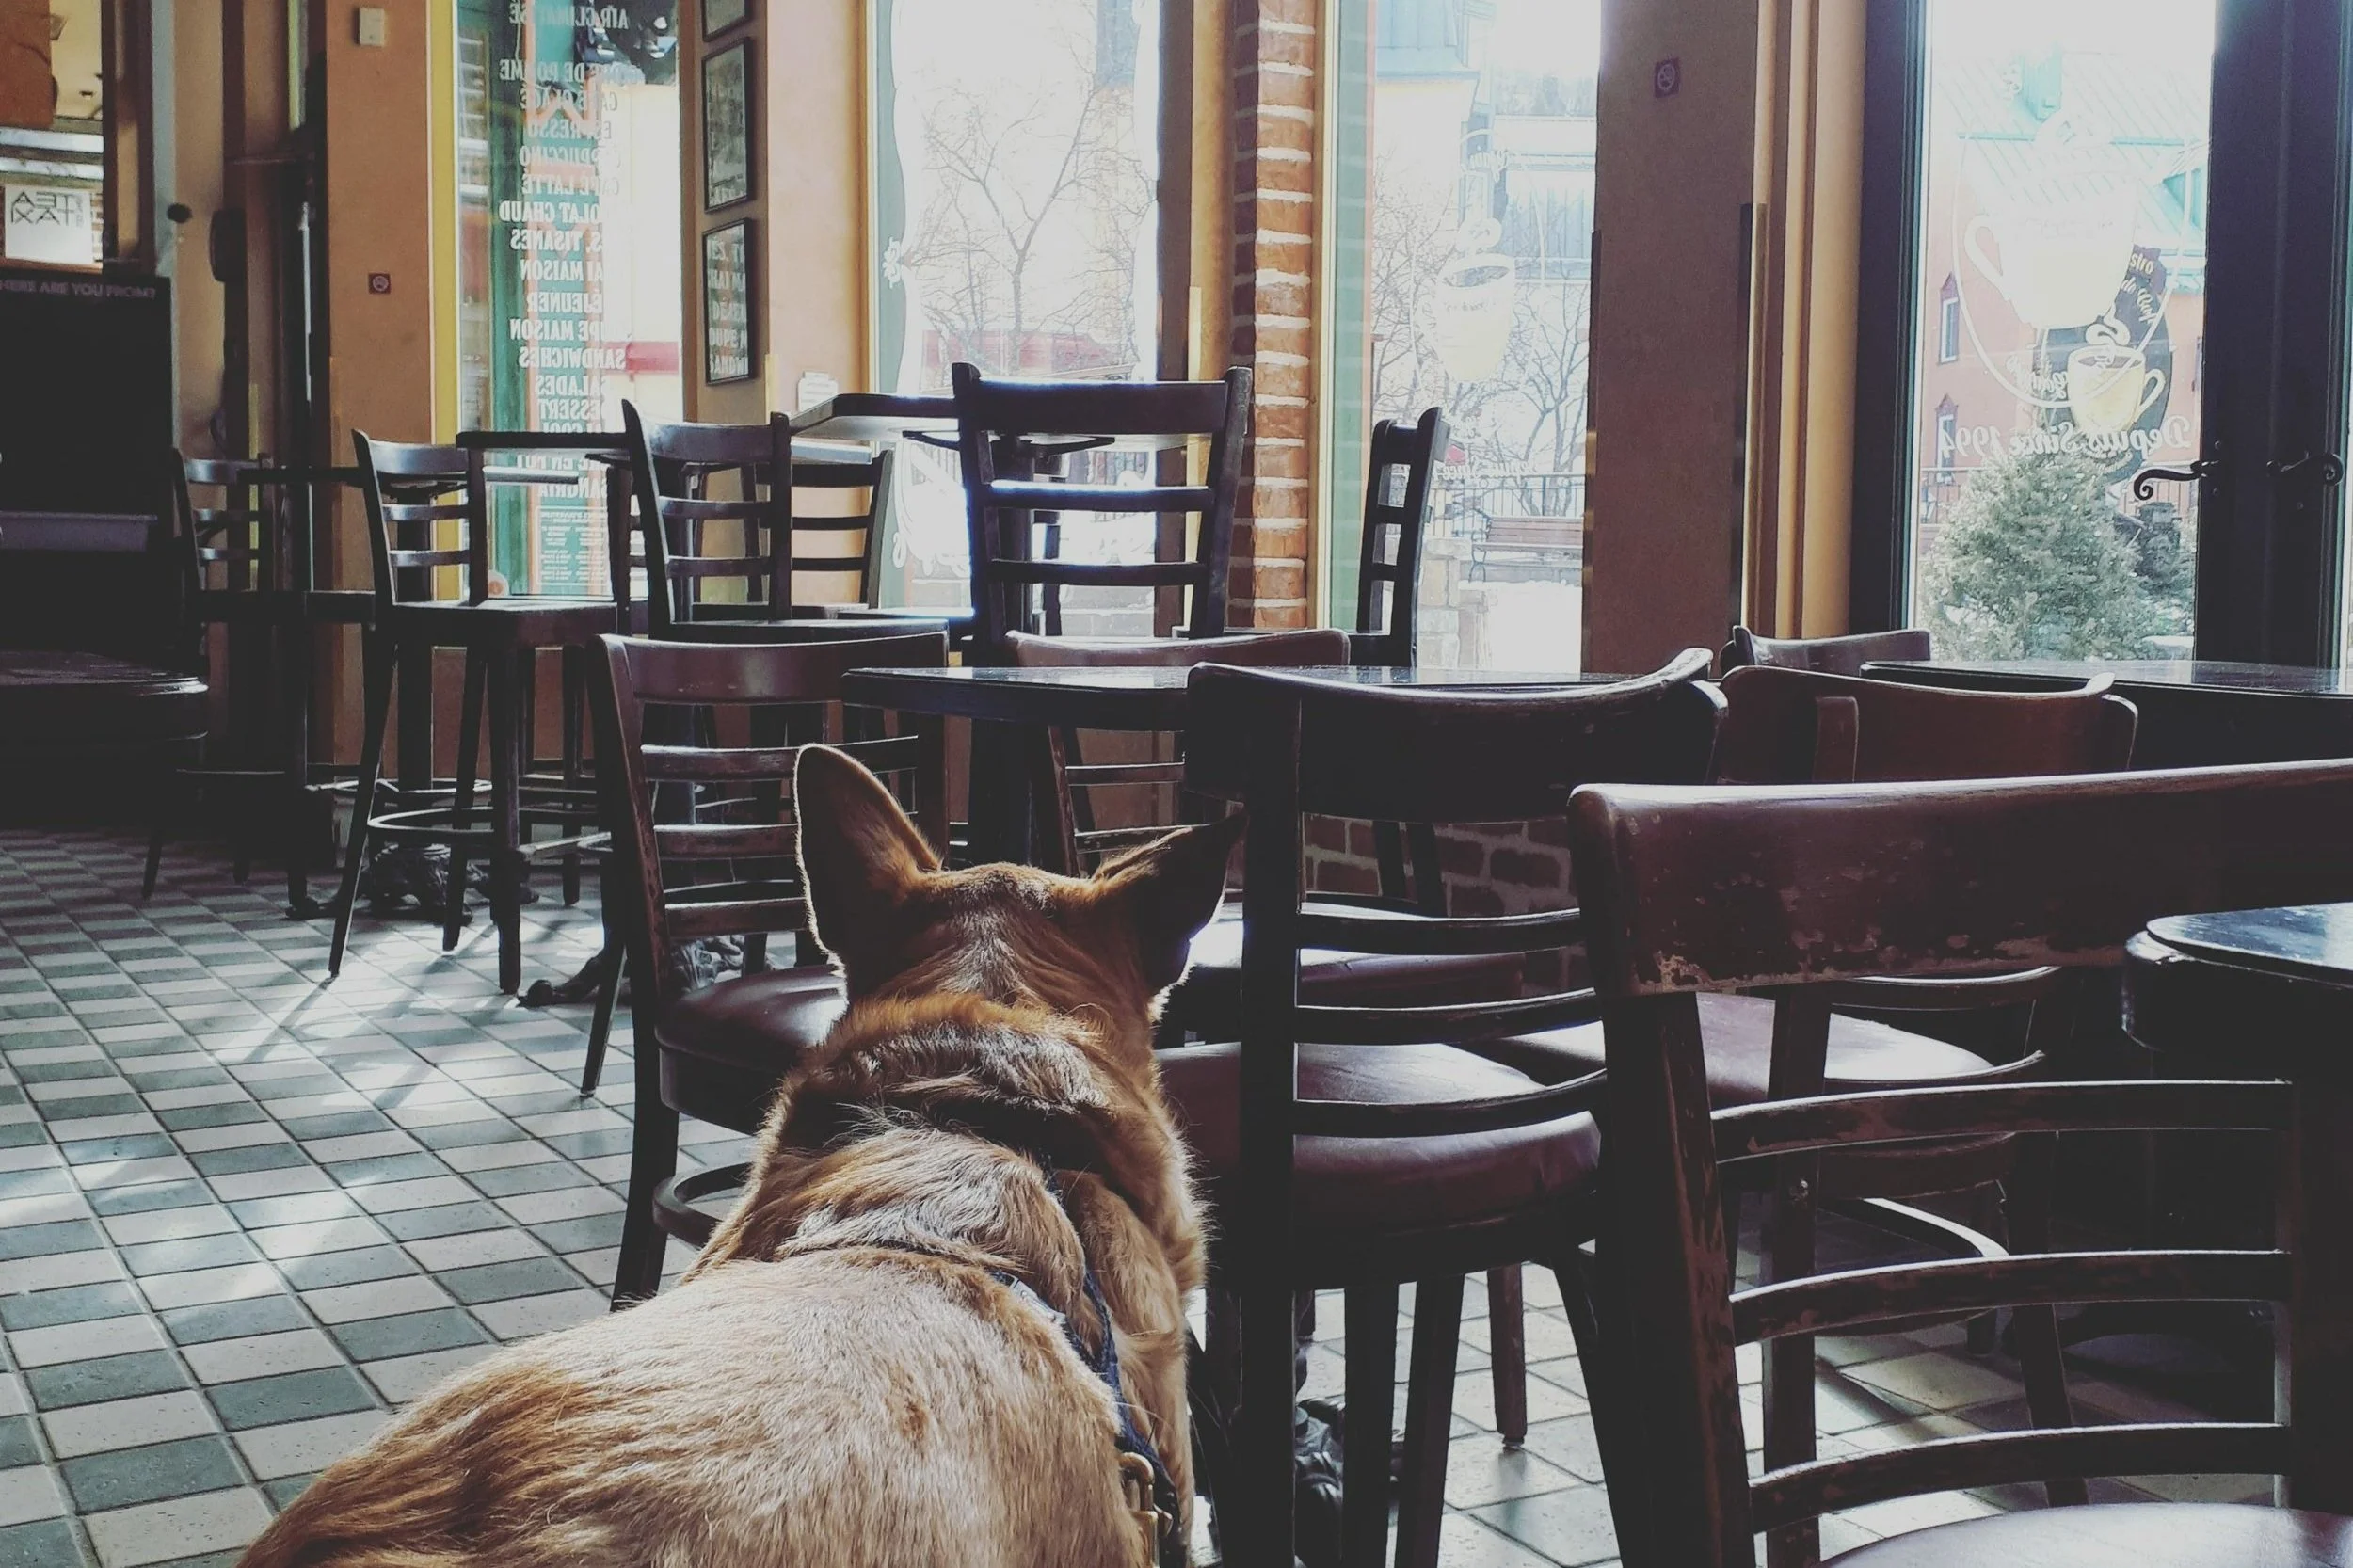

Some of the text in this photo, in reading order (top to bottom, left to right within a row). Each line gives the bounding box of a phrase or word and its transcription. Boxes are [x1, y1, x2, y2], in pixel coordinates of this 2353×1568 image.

[40, 281, 69, 295] ARE
[71, 282, 103, 297] YOU
[106, 285, 156, 299] FROM?
